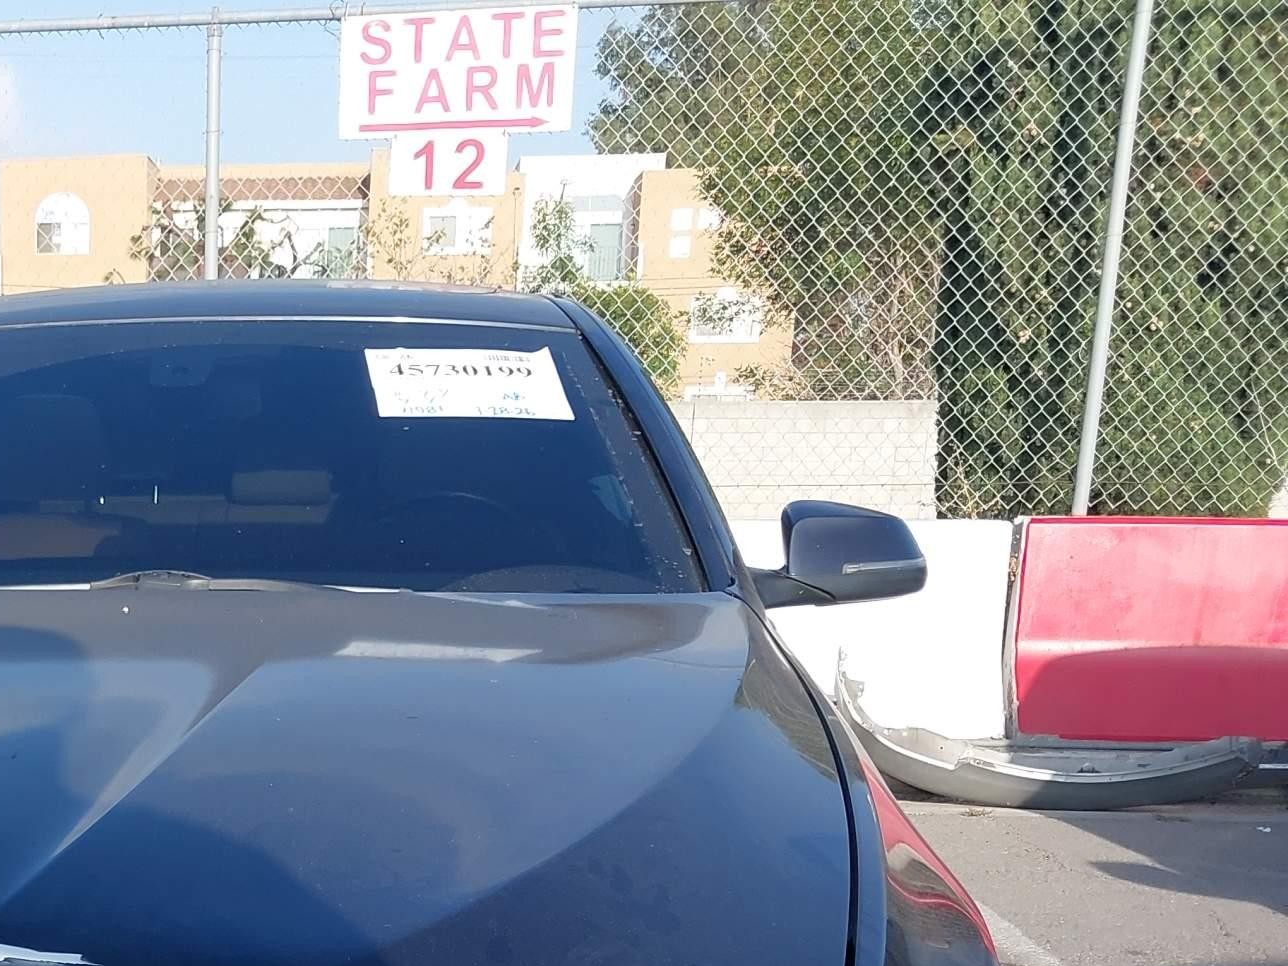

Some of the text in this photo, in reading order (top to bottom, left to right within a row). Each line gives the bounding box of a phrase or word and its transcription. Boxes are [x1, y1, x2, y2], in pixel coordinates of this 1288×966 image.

[359, 9, 566, 65] STATE
[368, 62, 555, 115] FARM
[413, 138, 486, 191] 12
[389, 362, 533, 378] 45730199
